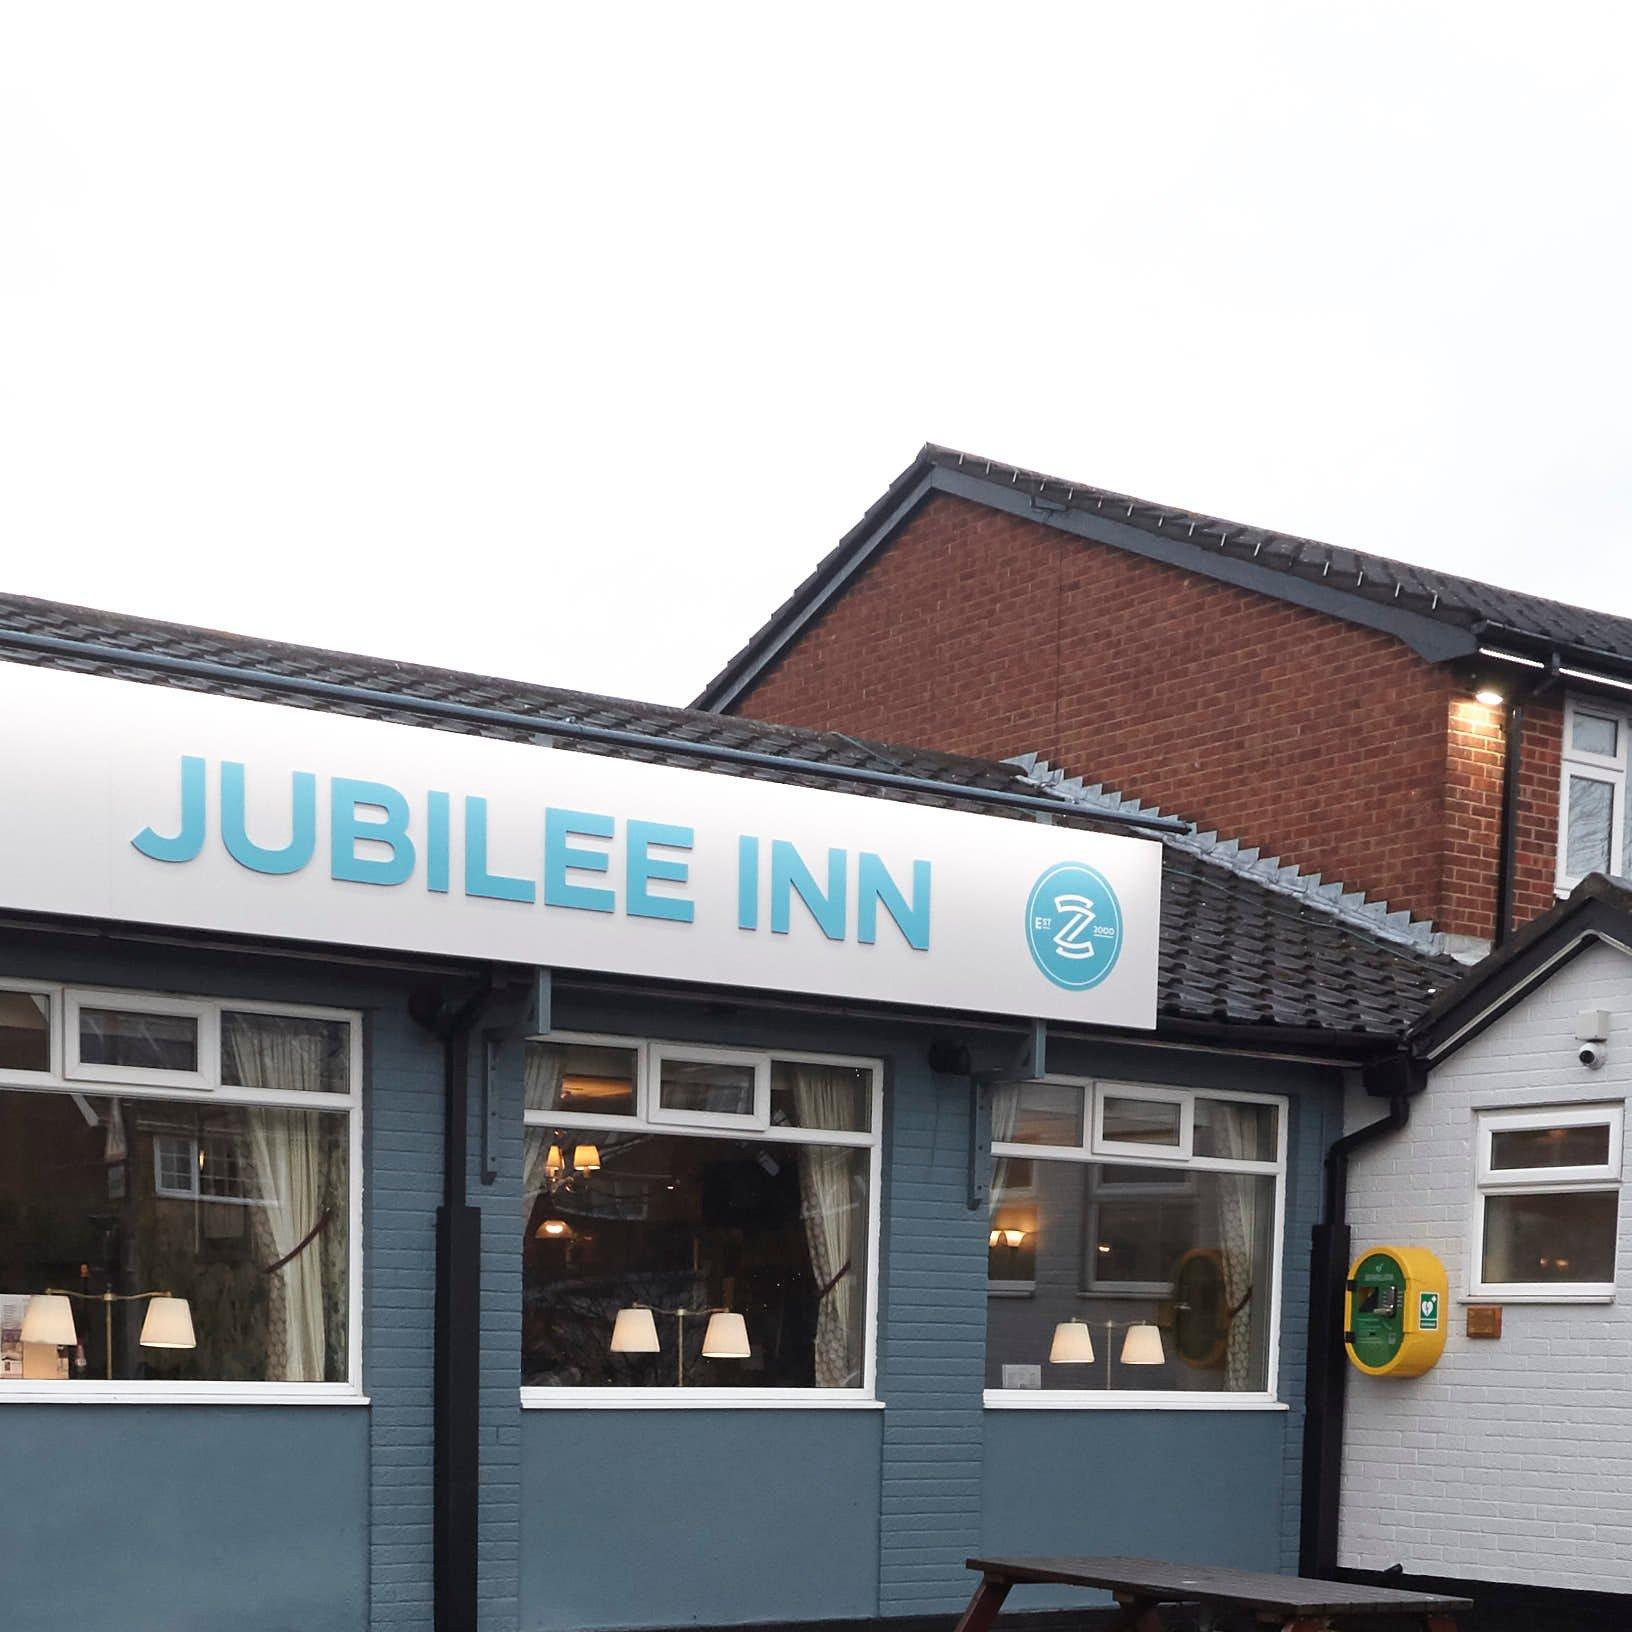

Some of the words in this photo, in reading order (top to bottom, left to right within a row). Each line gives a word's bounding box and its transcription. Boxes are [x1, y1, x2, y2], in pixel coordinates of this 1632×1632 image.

[132, 758, 696, 924] JUBILEE
[738, 835, 931, 950] INN
[1093, 925, 1116, 936] 2000
